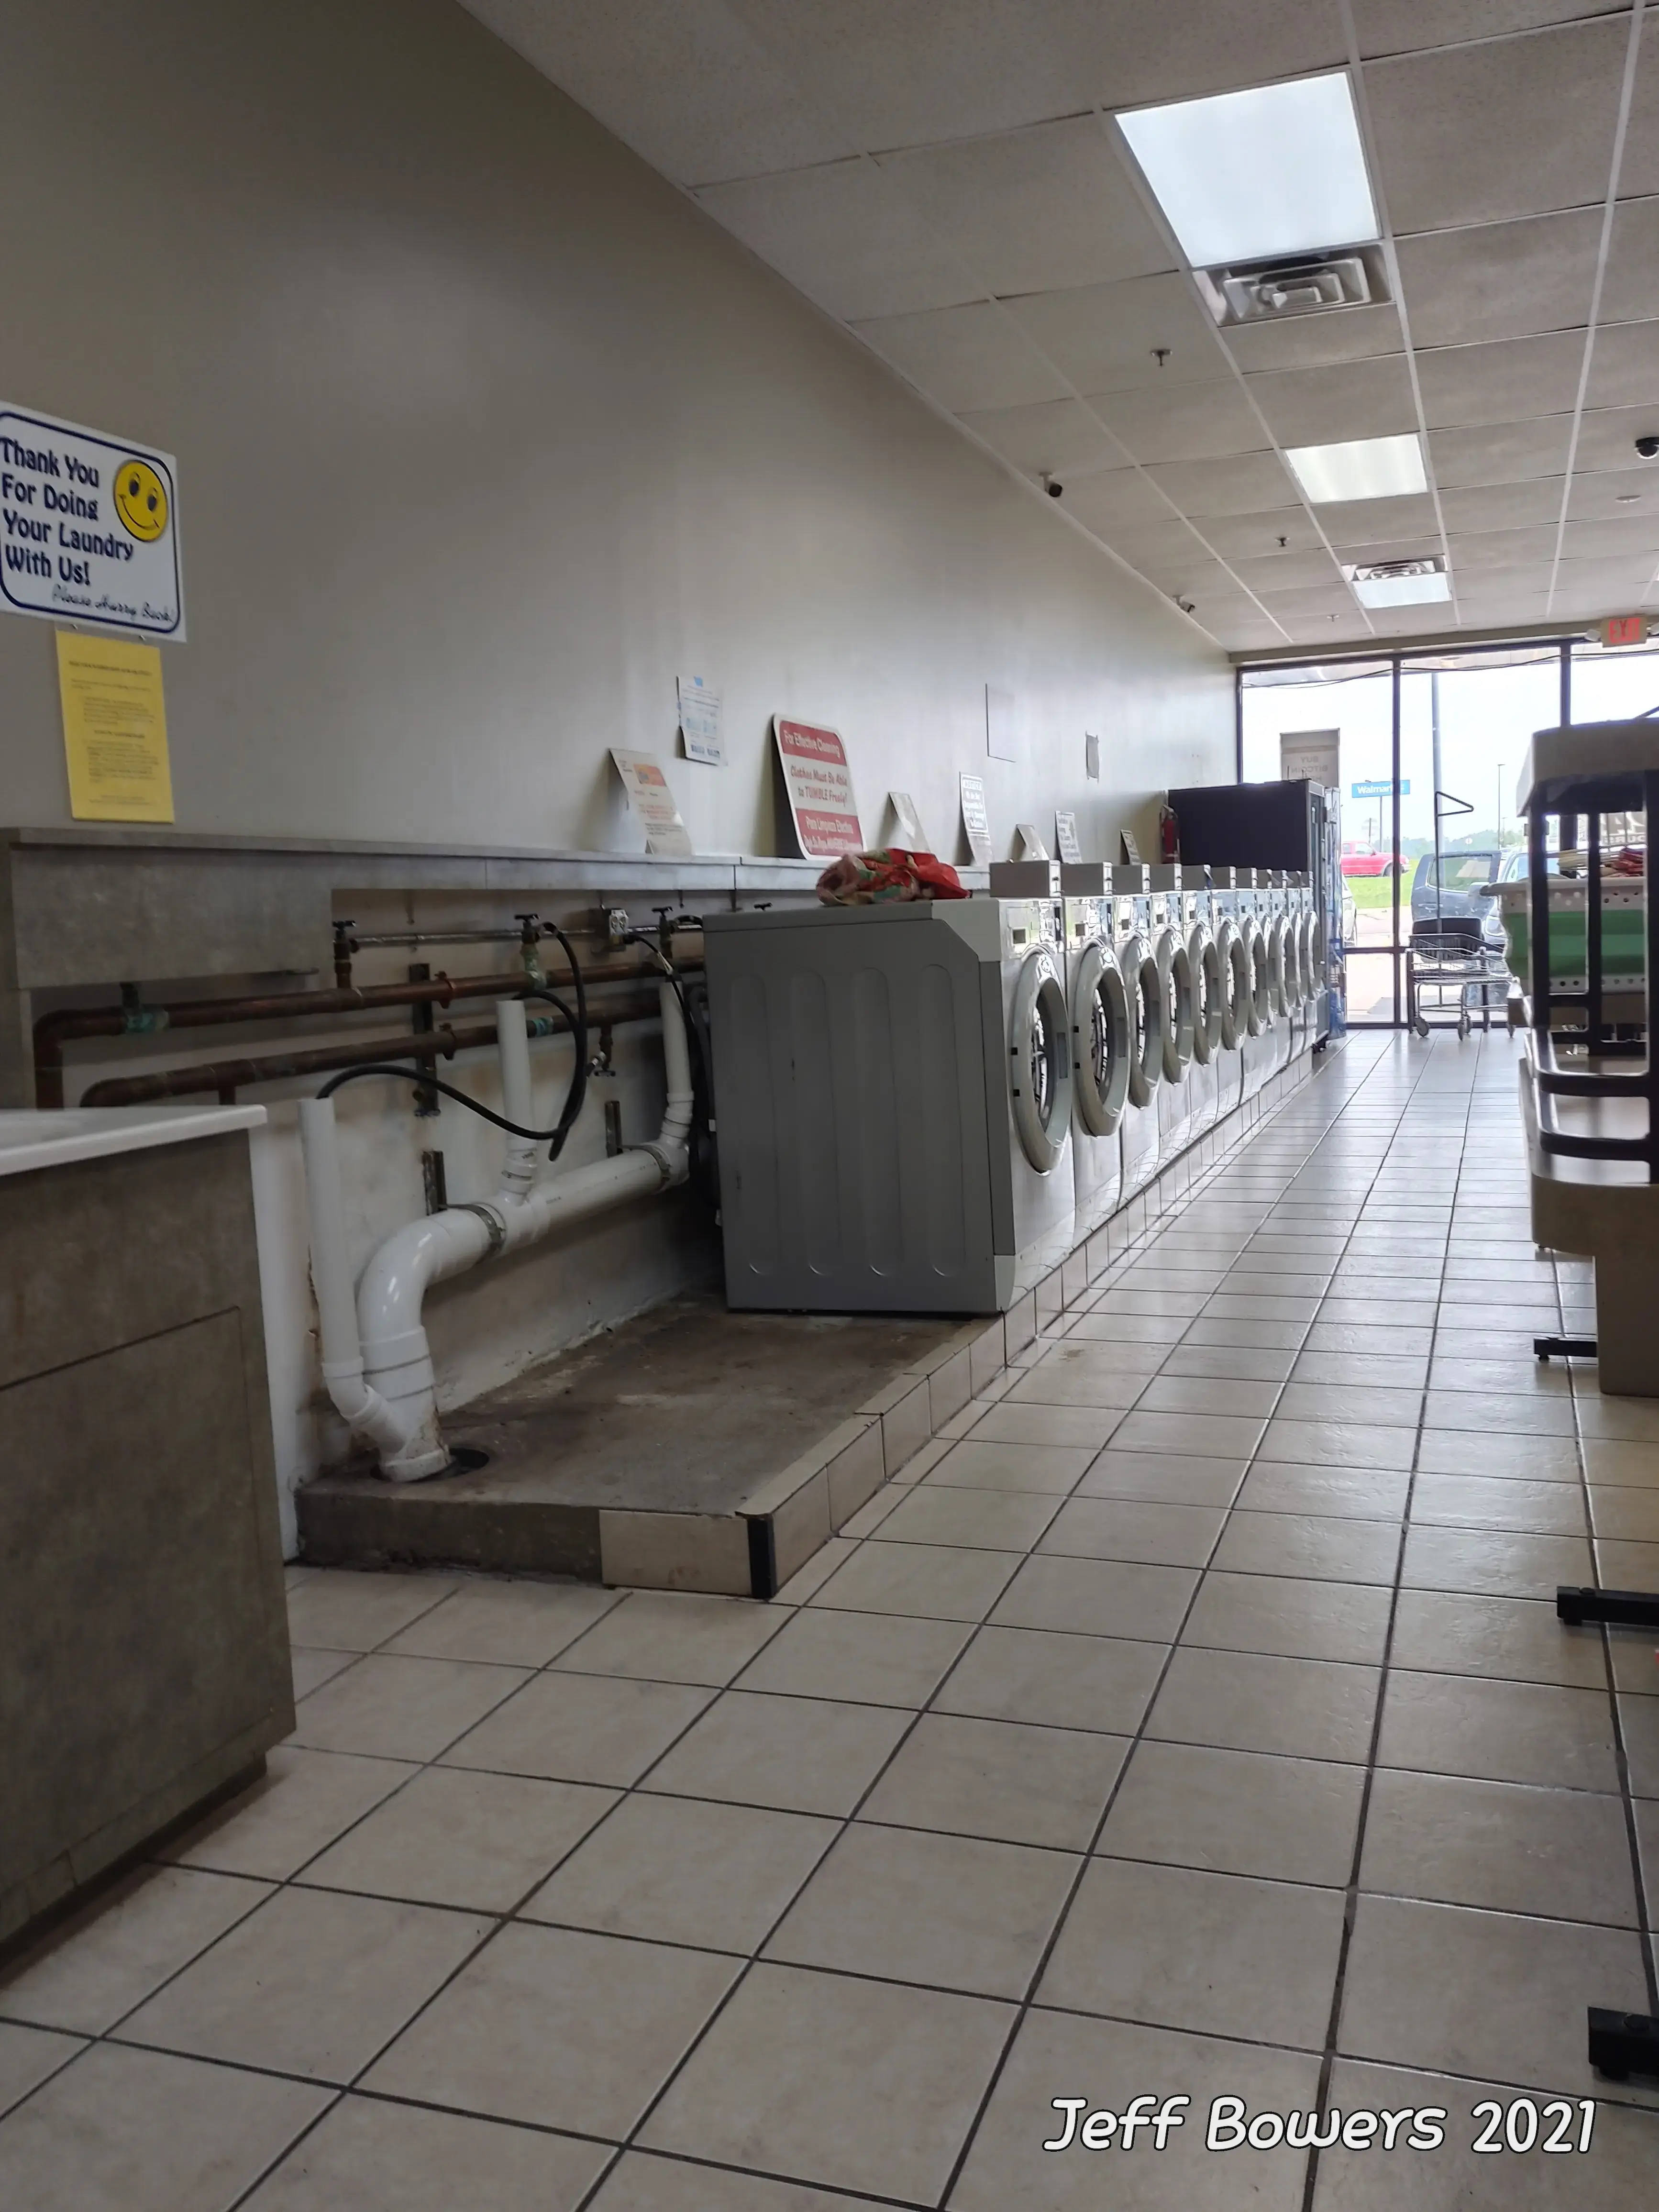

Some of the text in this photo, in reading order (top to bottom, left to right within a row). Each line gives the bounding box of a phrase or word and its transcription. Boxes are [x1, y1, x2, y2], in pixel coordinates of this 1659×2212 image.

[0, 436, 99, 488] Thank You
[1, 472, 99, 521] For Doing
[3, 508, 133, 562] Your Laundry
[5, 543, 90, 586] With Us!
[1609, 617, 1641, 644] EXIT
